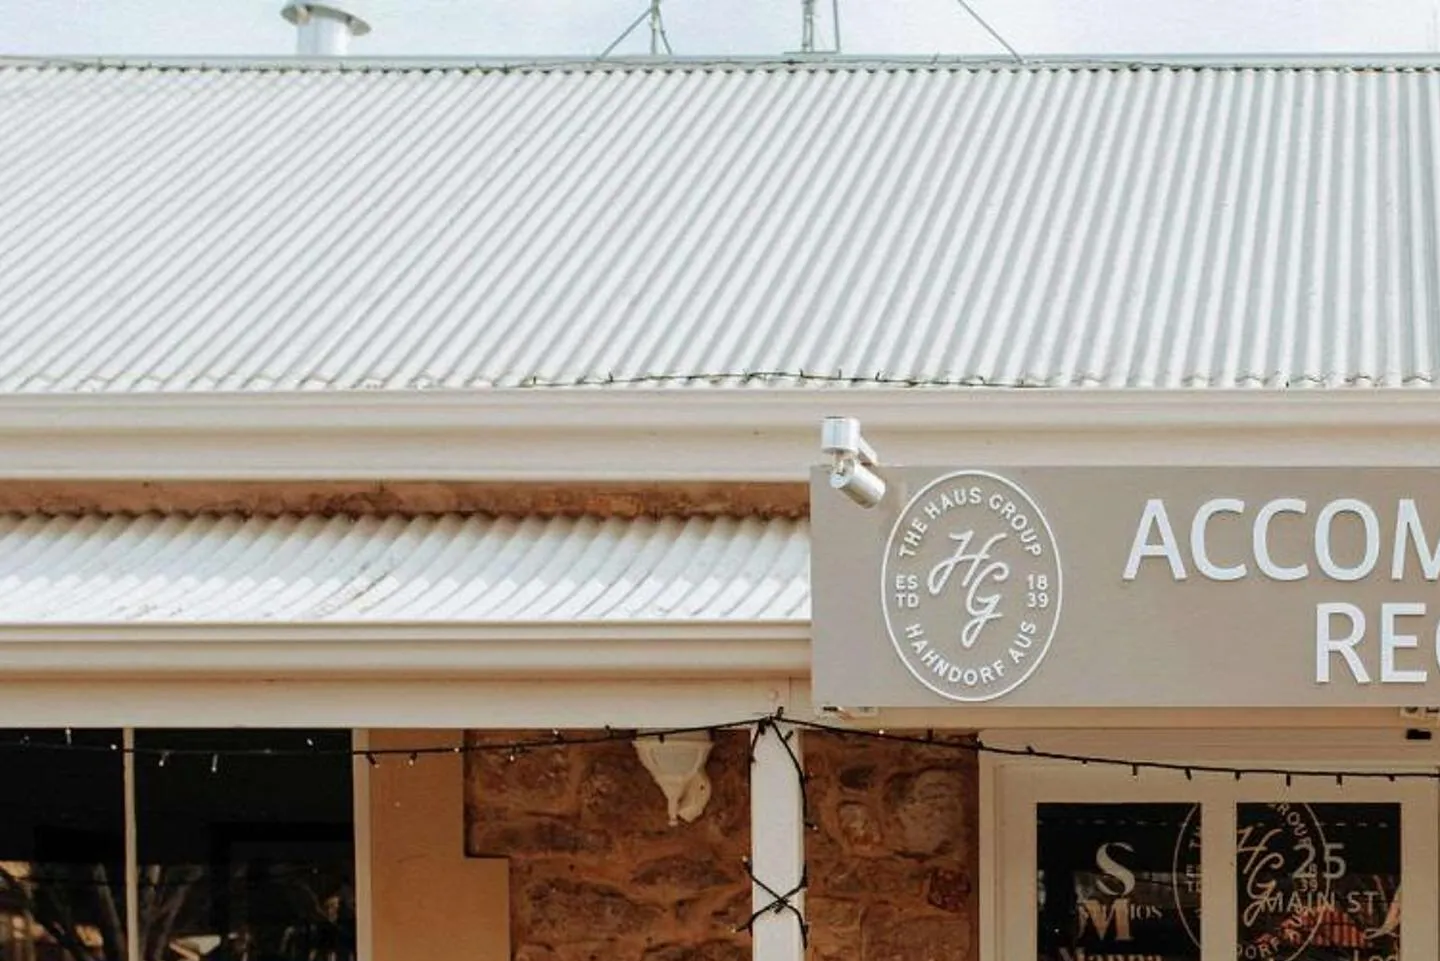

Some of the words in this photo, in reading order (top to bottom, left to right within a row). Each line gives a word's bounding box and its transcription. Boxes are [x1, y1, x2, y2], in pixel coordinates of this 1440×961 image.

[900, 518, 928, 558] THE
[925, 487, 982, 520] HAUS
[989, 494, 1042, 557] GROUP
[895, 575, 918, 590] ES
[1028, 574, 1048, 590] 18
[895, 593, 920, 608] TD
[1027, 593, 1049, 608] 39
[905, 623, 1007, 685] HAHNDORF
[1008, 621, 1036, 663] AUS
[1292, 842, 1347, 879] 25
[1260, 890, 1336, 913] MAIN
[1347, 890, 1380, 914] ST
